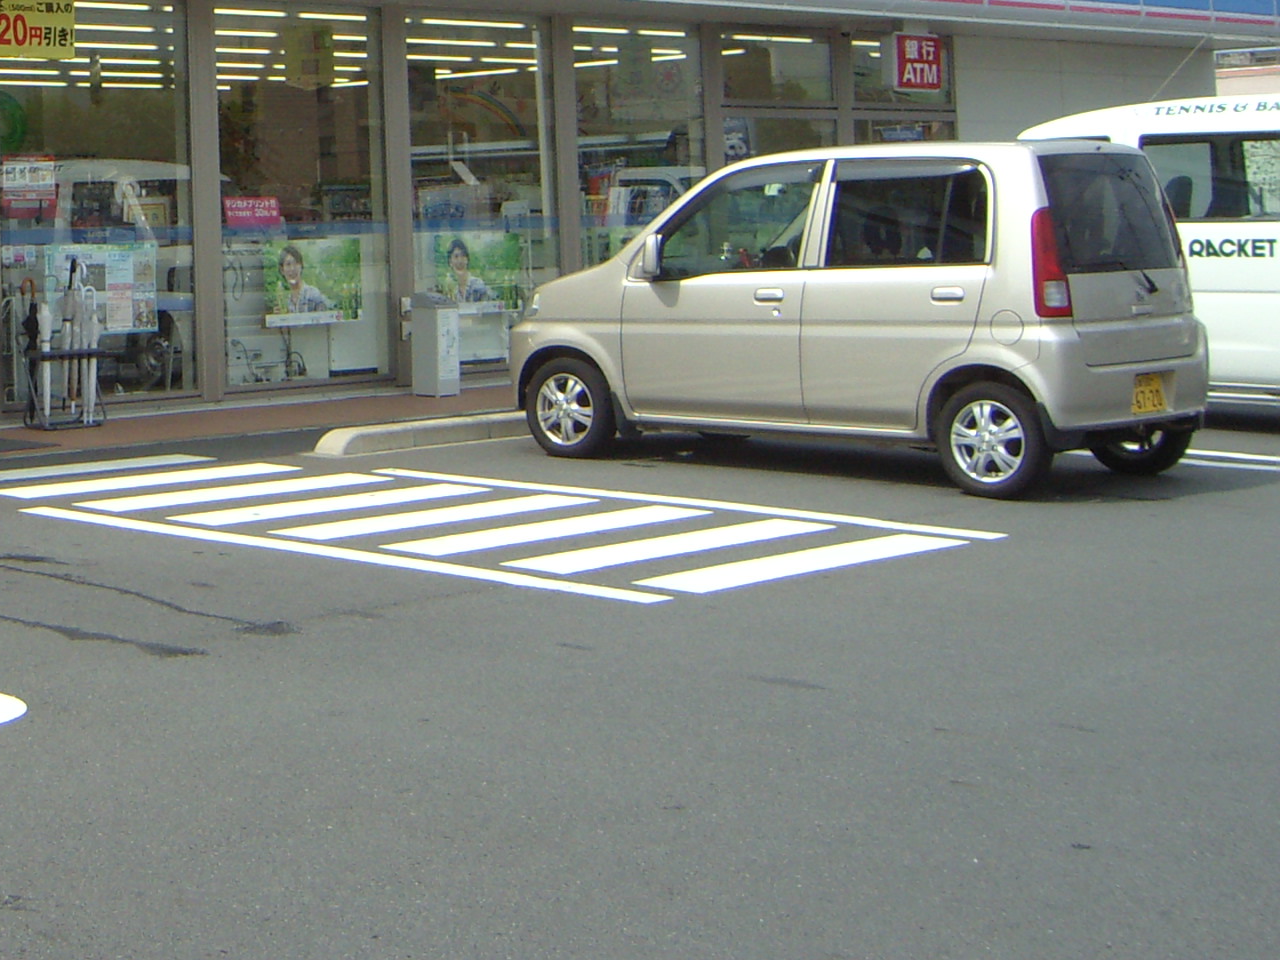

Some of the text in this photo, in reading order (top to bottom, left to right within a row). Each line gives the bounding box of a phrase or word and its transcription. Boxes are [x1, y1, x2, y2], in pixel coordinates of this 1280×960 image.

[904, 39, 937, 61] 銀行
[902, 62, 938, 84] ATM
[1154, 103, 1228, 116] TENNIS
[1233, 102, 1249, 113] &
[1188, 239, 1278, 258] RACKET
